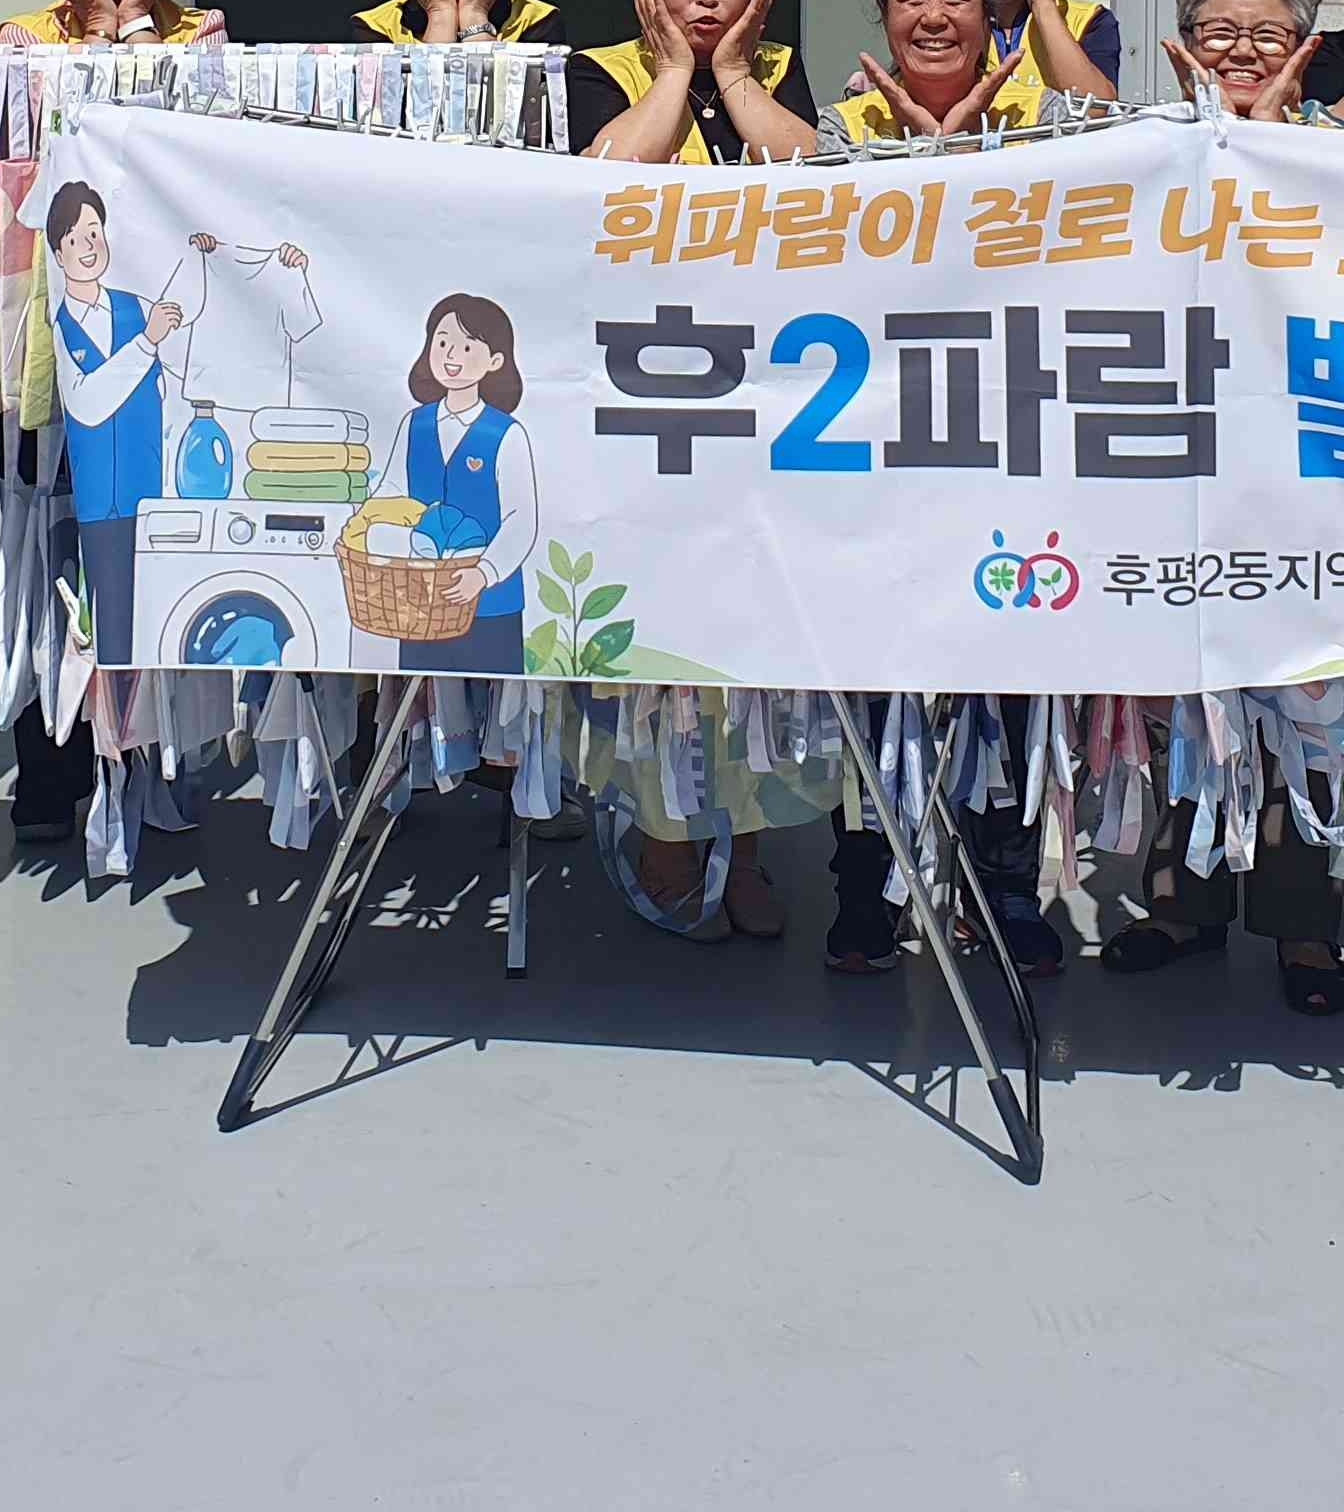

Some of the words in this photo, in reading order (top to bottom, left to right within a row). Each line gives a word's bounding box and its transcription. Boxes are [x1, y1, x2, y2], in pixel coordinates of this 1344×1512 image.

[595, 182, 945, 270] 휘파람이
[965, 180, 1133, 268] 절로
[1161, 178, 1323, 267] 나는
[595, 305, 1230, 479] 후2파람
